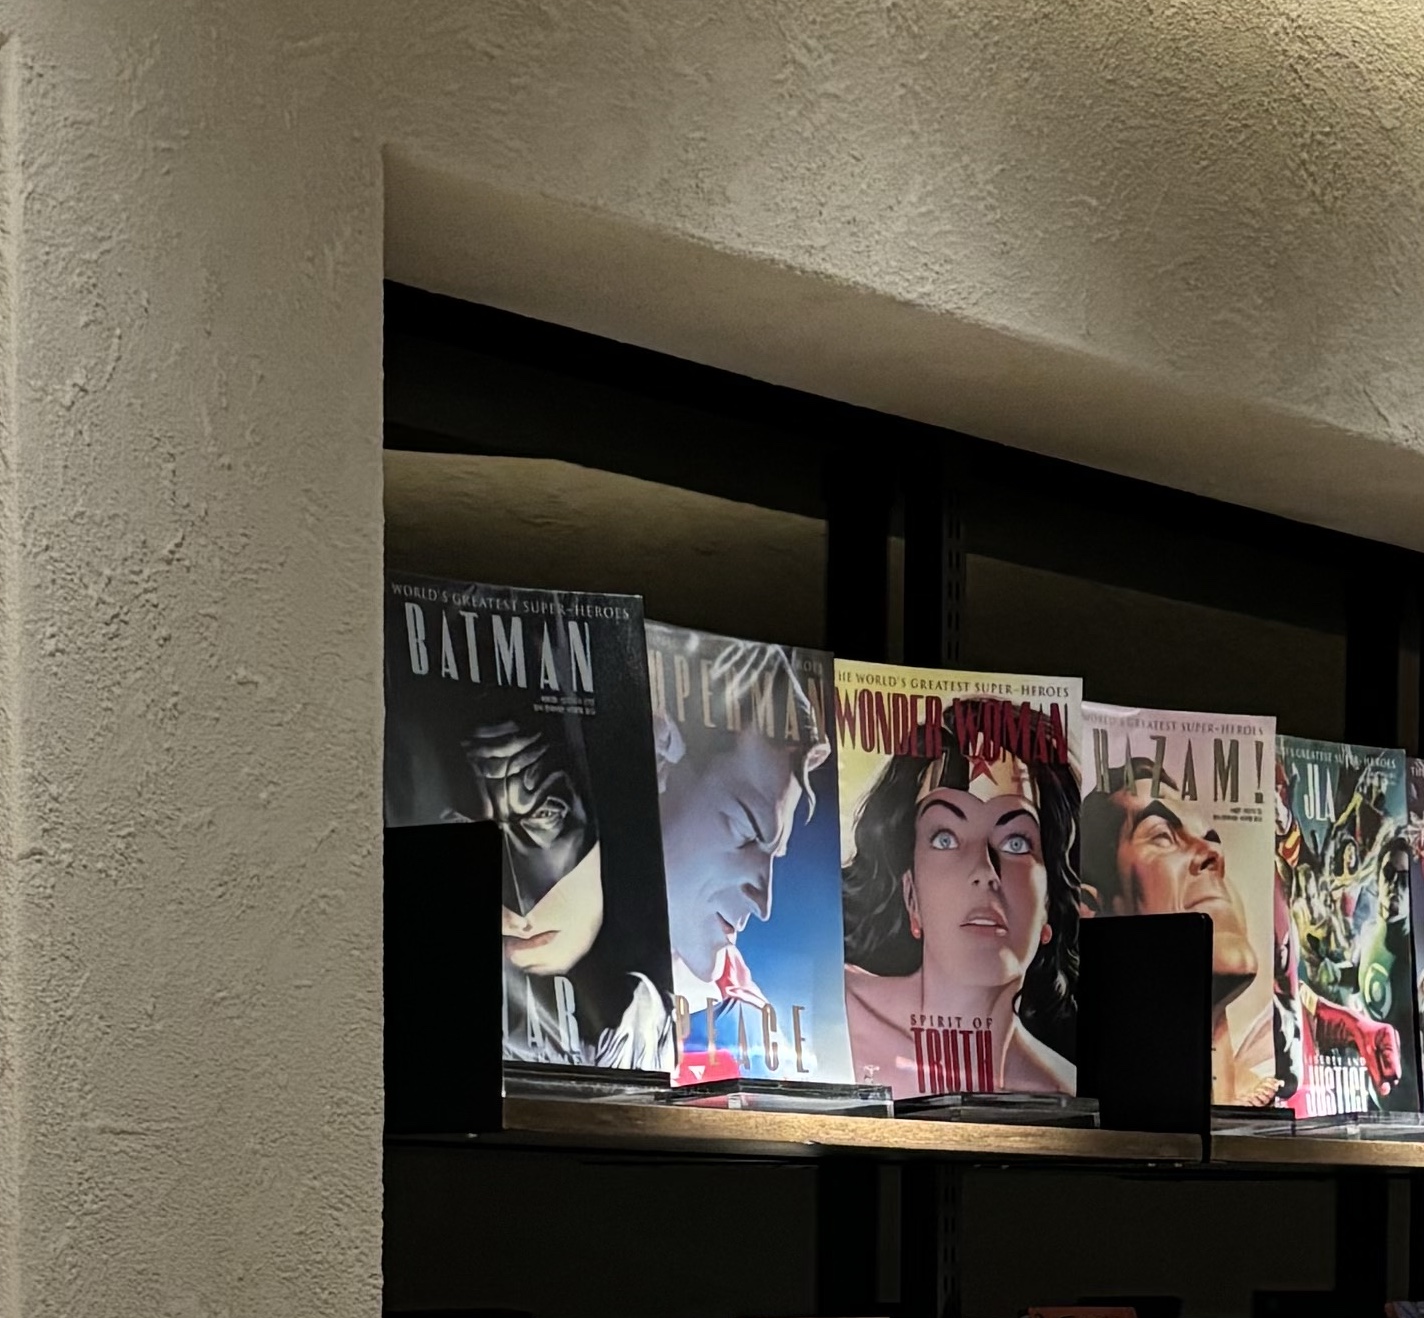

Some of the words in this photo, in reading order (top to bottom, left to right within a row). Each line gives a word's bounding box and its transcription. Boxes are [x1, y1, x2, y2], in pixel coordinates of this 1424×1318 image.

[404, 602, 594, 693] BATMAN
[837, 672, 852, 684] HE
[856, 673, 907, 688] WORLD'S
[910, 678, 969, 693] GREATEST
[974, 681, 1070, 698] SUPER-HEROES
[648, 649, 826, 744] UPERMAN
[834, 686, 943, 758] WONDER
[953, 697, 1069, 765] WOMAN
[1093, 728, 1264, 804] HAZAM!
[1303, 762, 1336, 823] JLA
[503, 972, 580, 1055] AR
[674, 994, 811, 1074] PEACE
[910, 1013, 963, 1028] SPIRIT
[972, 1016, 994, 1030] OF
[910, 1027, 994, 1094] TRUTH
[1305, 1066, 1369, 1117] JUSTICE
